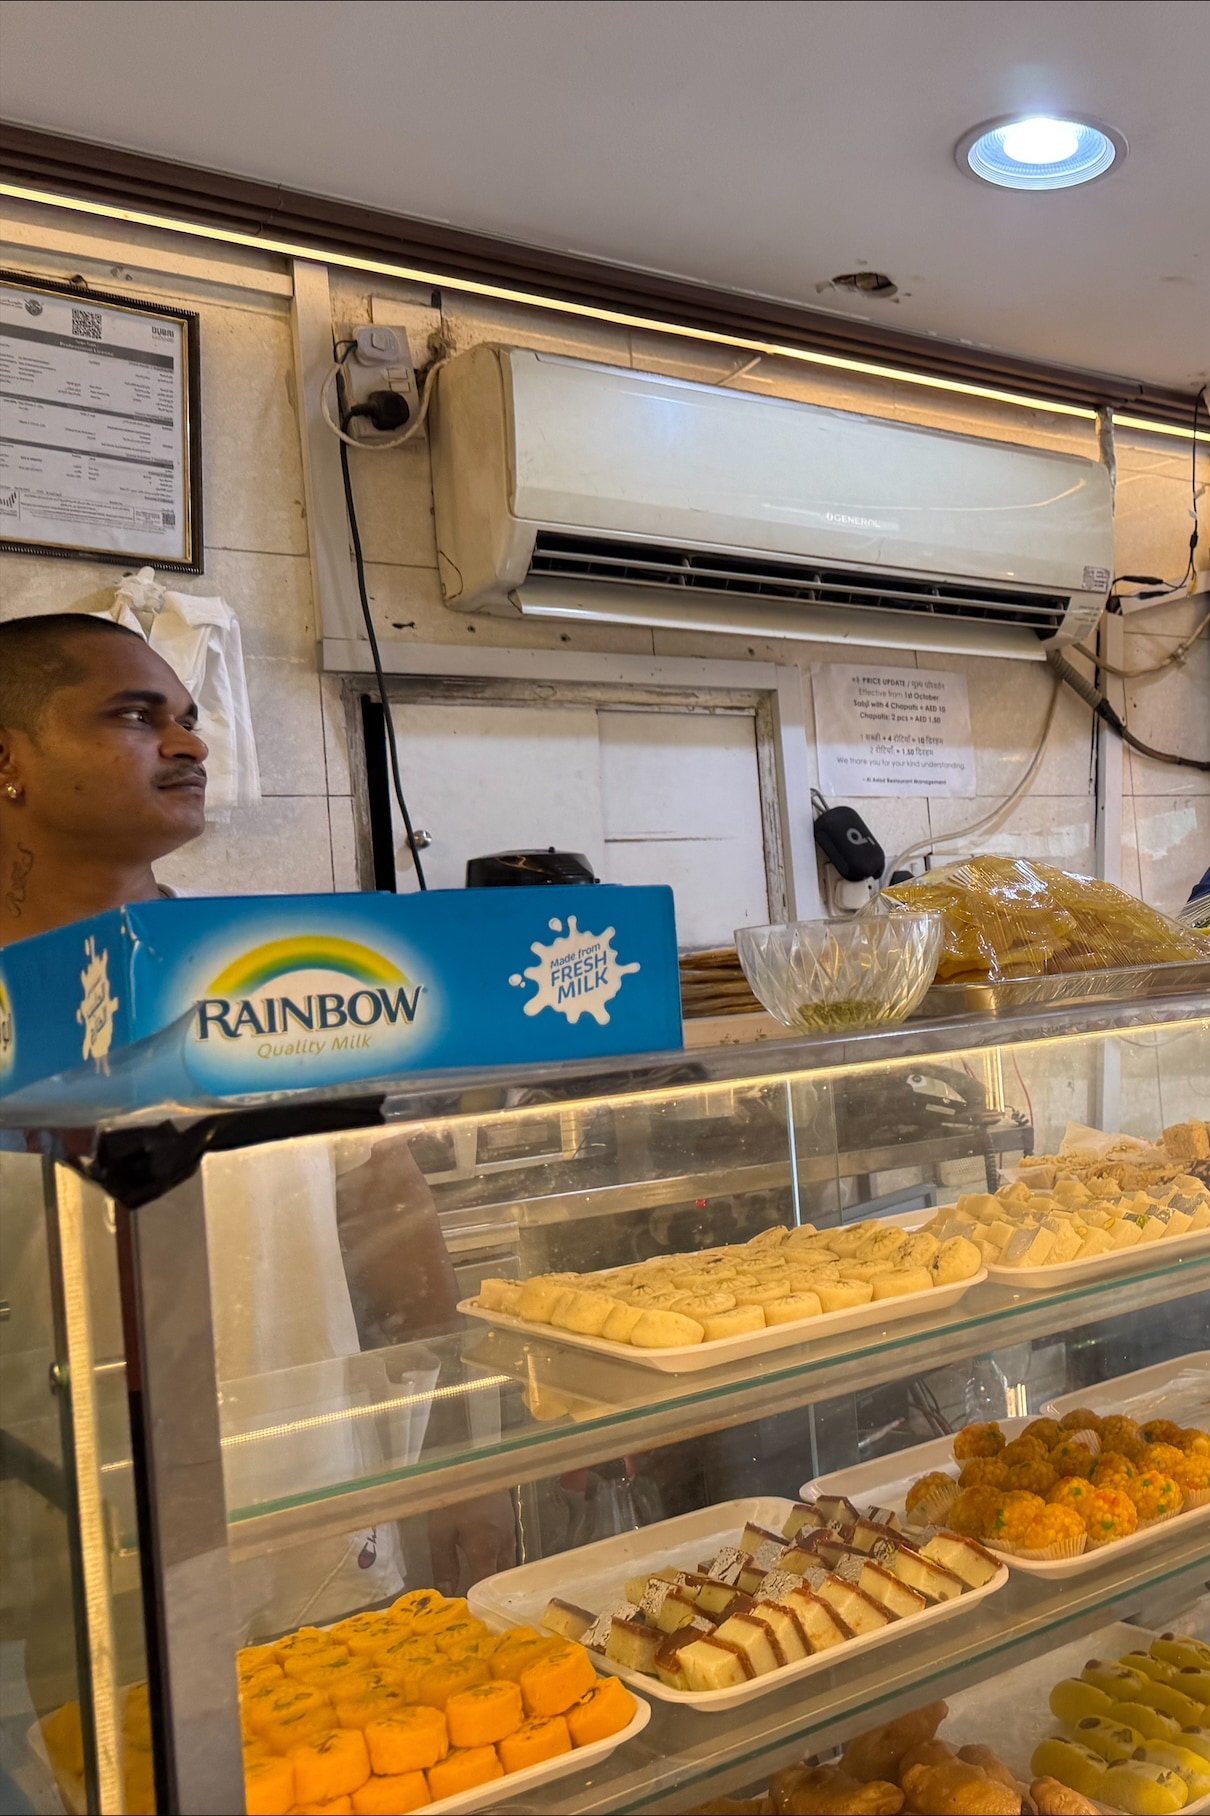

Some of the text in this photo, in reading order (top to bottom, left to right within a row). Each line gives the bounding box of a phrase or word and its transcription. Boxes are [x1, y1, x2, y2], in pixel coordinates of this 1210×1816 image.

[862, 677, 881, 685] PRICE
[882, 678, 905, 687] UPDATE
[858, 688, 886, 697] Effective
[888, 689, 903, 697] from
[913, 692, 939, 701] October
[853, 699, 870, 709] Sabji
[871, 700, 884, 708] with
[890, 702, 919, 711] Chapatis
[902, 748, 914, 756] 1.50
[849, 757, 867, 765] thank
[869, 759, 880, 767] you
[881, 758, 891, 766] for
[892, 761, 905, 769] your
[906, 760, 920, 768] kind
[550, 943, 601, 969] Made from
[551, 950, 607, 987] FRESH
[557, 966, 609, 1004] MILK
[195, 985, 423, 1042] RAINBOW
[257, 1033, 372, 1059] Quality Milk
